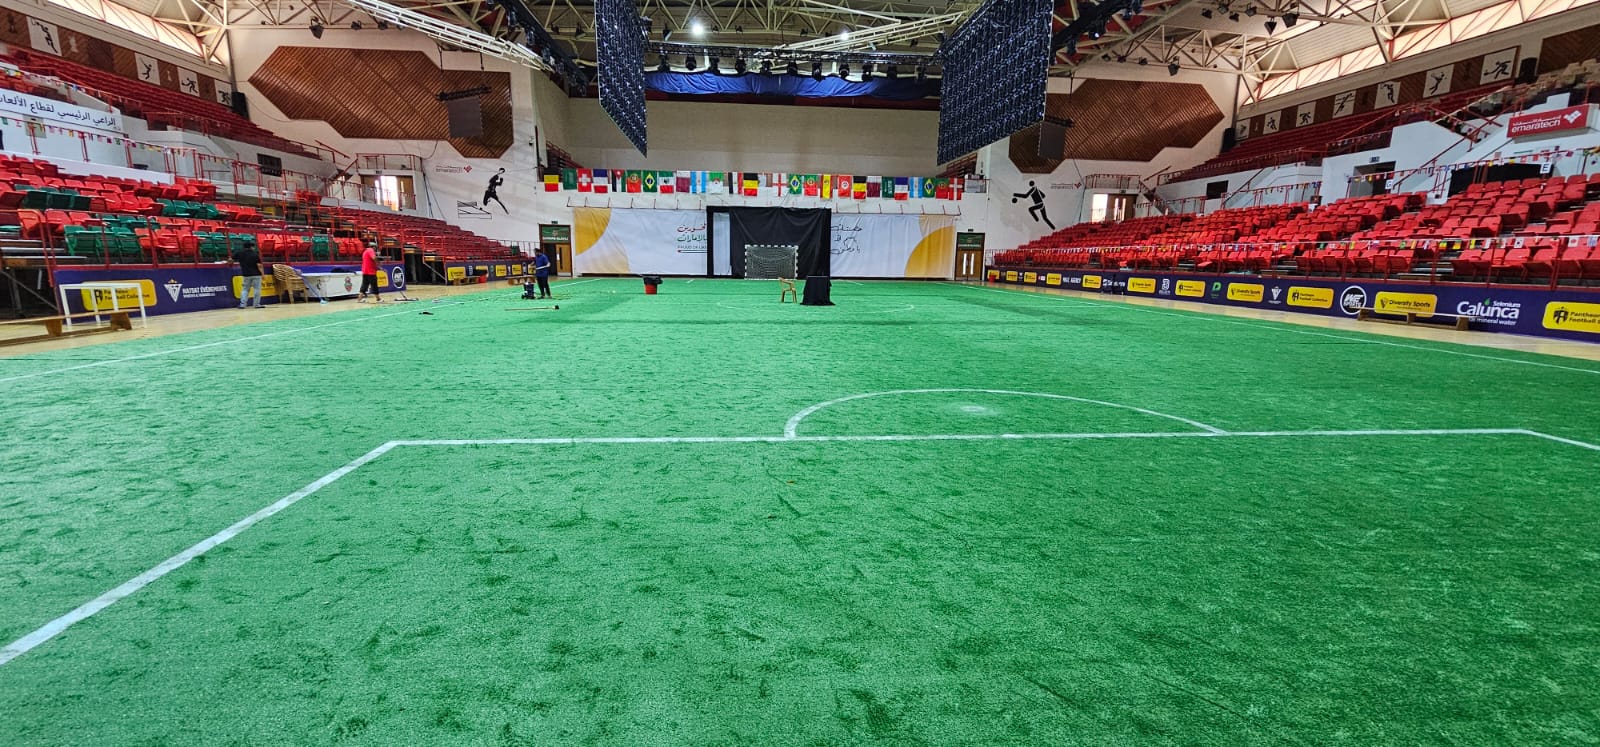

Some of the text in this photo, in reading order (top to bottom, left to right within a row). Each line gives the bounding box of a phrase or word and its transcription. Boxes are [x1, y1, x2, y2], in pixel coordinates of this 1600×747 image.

[30, 101, 55, 114] لقطاع
[57, 109, 91, 121] الرئيسي
[93, 117, 116, 127] الراعي
[1512, 119, 1561, 133] emaratech
[1542, 163, 1549, 172] E
[1457, 300, 1520, 319] Calunca
[1493, 300, 1521, 308] Selenium
